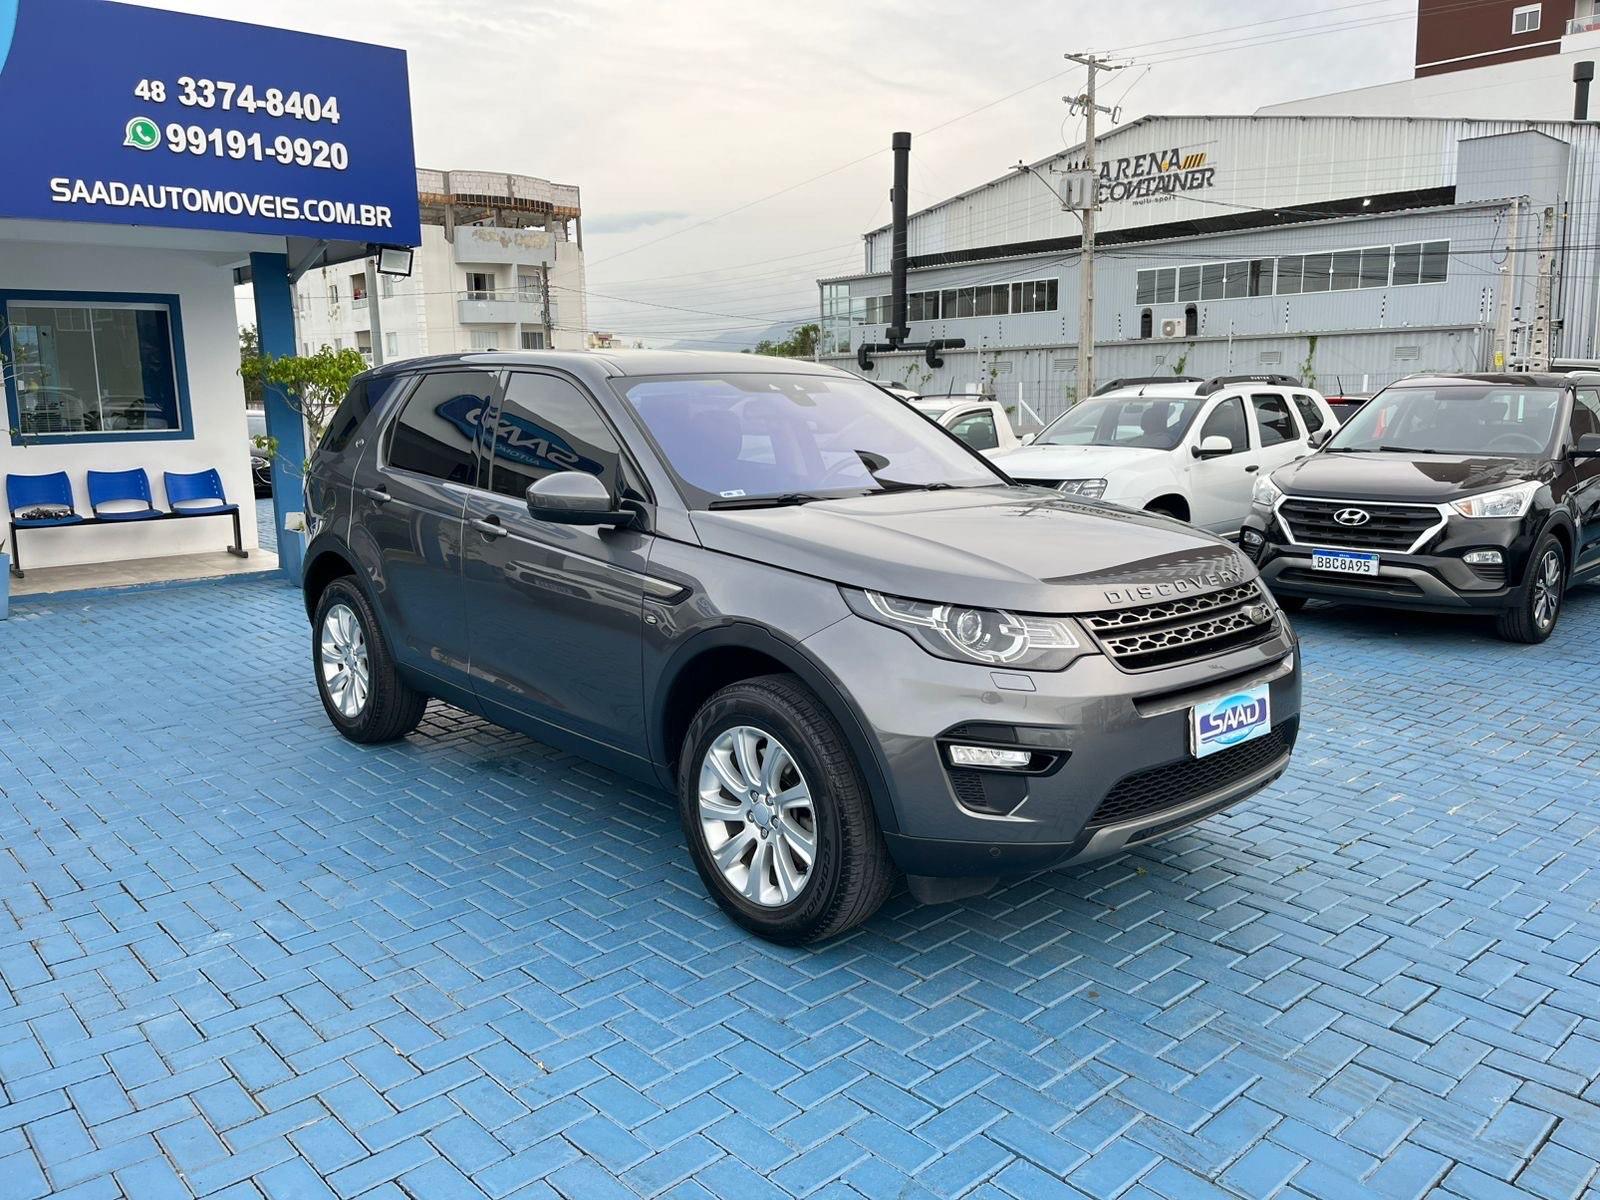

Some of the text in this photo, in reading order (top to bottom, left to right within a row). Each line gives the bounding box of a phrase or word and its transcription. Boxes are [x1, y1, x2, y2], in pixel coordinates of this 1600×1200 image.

[134, 76, 341, 124] 48 3374-8404
[166, 123, 349, 171] 99191-9920
[1100, 148, 1182, 181] ARENA
[50, 178, 392, 228] SAADAUTOMOVEIS.COM.BR
[1317, 556, 1370, 572] BBC8A95
[1104, 568, 1243, 604] DISCOVERY
[1206, 701, 1260, 736] SAAD
